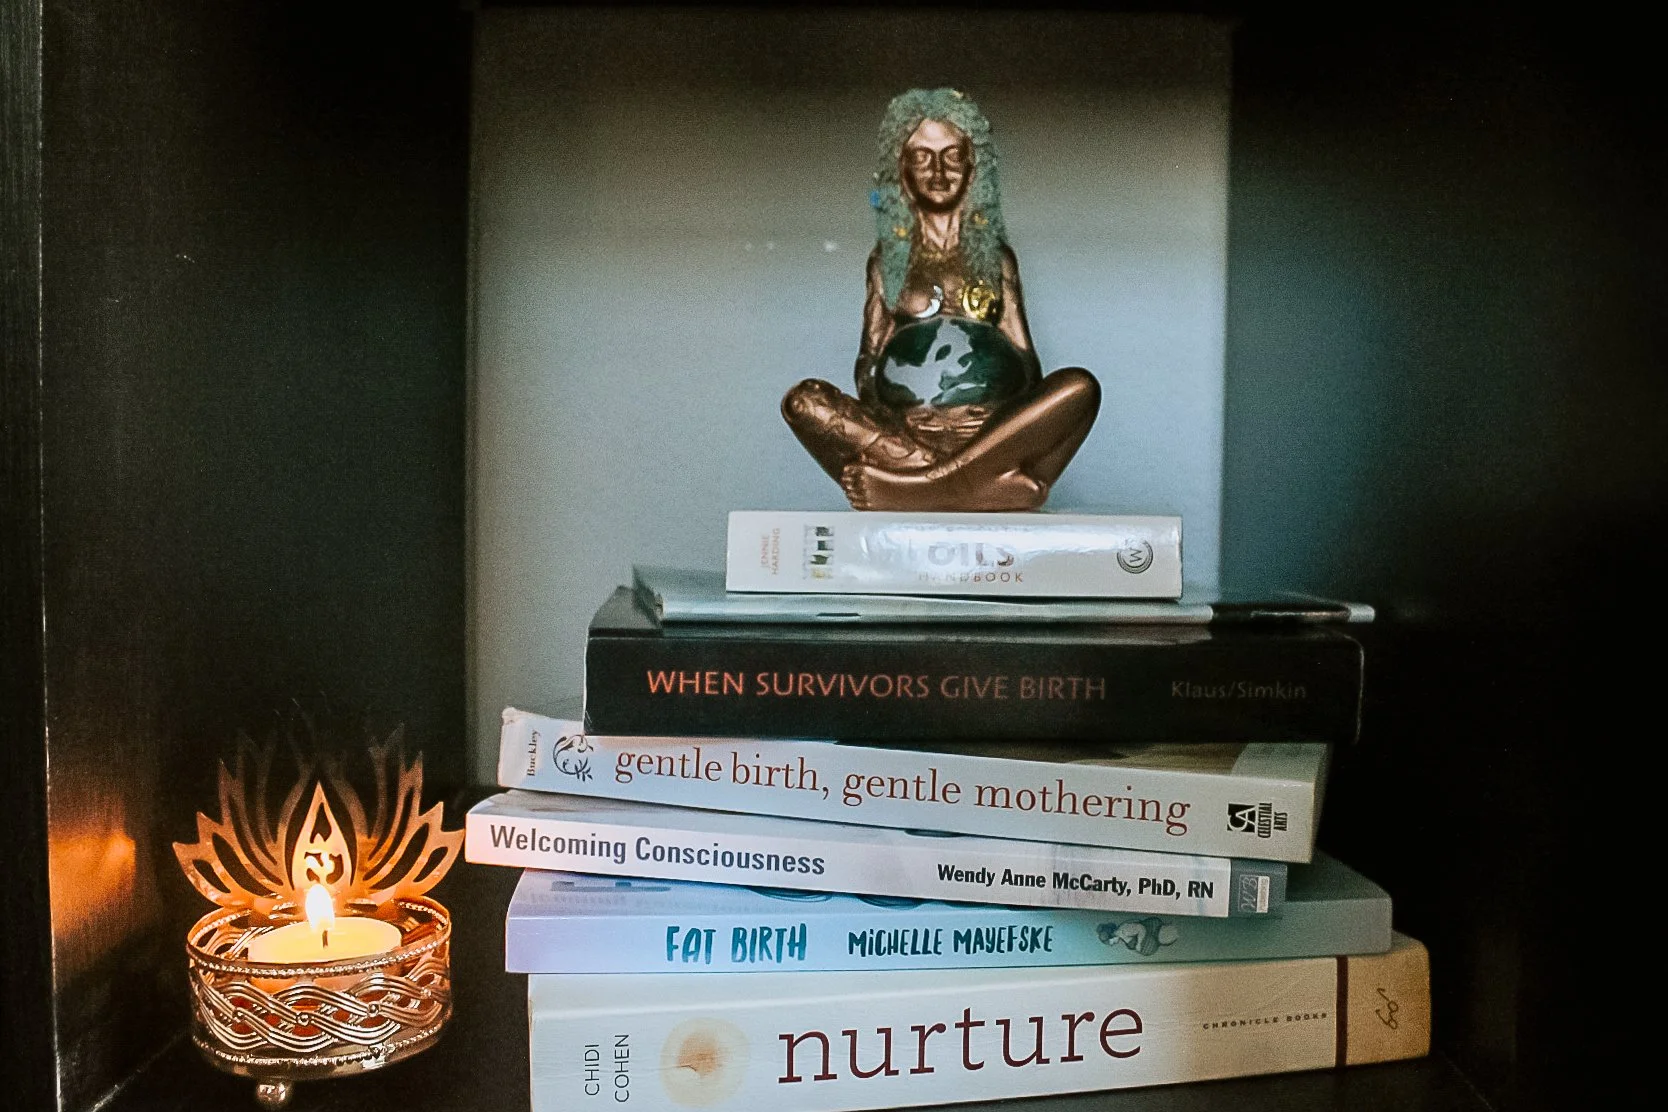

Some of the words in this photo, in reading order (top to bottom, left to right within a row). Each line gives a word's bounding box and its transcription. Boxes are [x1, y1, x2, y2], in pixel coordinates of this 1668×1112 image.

[648, 671, 743, 694] WHEN
[757, 672, 929, 697] SURVIVORS
[941, 676, 1008, 699] GIVE
[1020, 676, 1104, 700] BIRTH
[1172, 681, 1305, 699] Klaus/Simkin
[526, 730, 541, 777] Buckley
[616, 747, 722, 783] gentle
[731, 752, 828, 800] birth,
[843, 768, 961, 806] gentle
[974, 779, 1191, 837] mothering
[1257, 803, 1273, 838] CELESTIAL
[1273, 811, 1288, 832] ARTS
[490, 824, 627, 864] Welcoming
[635, 837, 826, 875] Consciousness
[938, 864, 995, 887] Wendy
[1001, 869, 1046, 888] Anne
[1053, 872, 1131, 896] McCarty,
[1139, 878, 1180, 900] PhD,
[1188, 881, 1213, 898] RN
[667, 926, 716, 964] FAT
[732, 923, 806, 963] BIRTH
[954, 926, 1053, 954] MAYEFSKE
[1203, 1016, 1279, 1030] CHRONICLE
[1286, 1012, 1327, 1022] BOOKS
[778, 1007, 1143, 1084] nurture
[585, 1045, 599, 1095] CHIDI
[615, 1035, 629, 1102] COHEN
